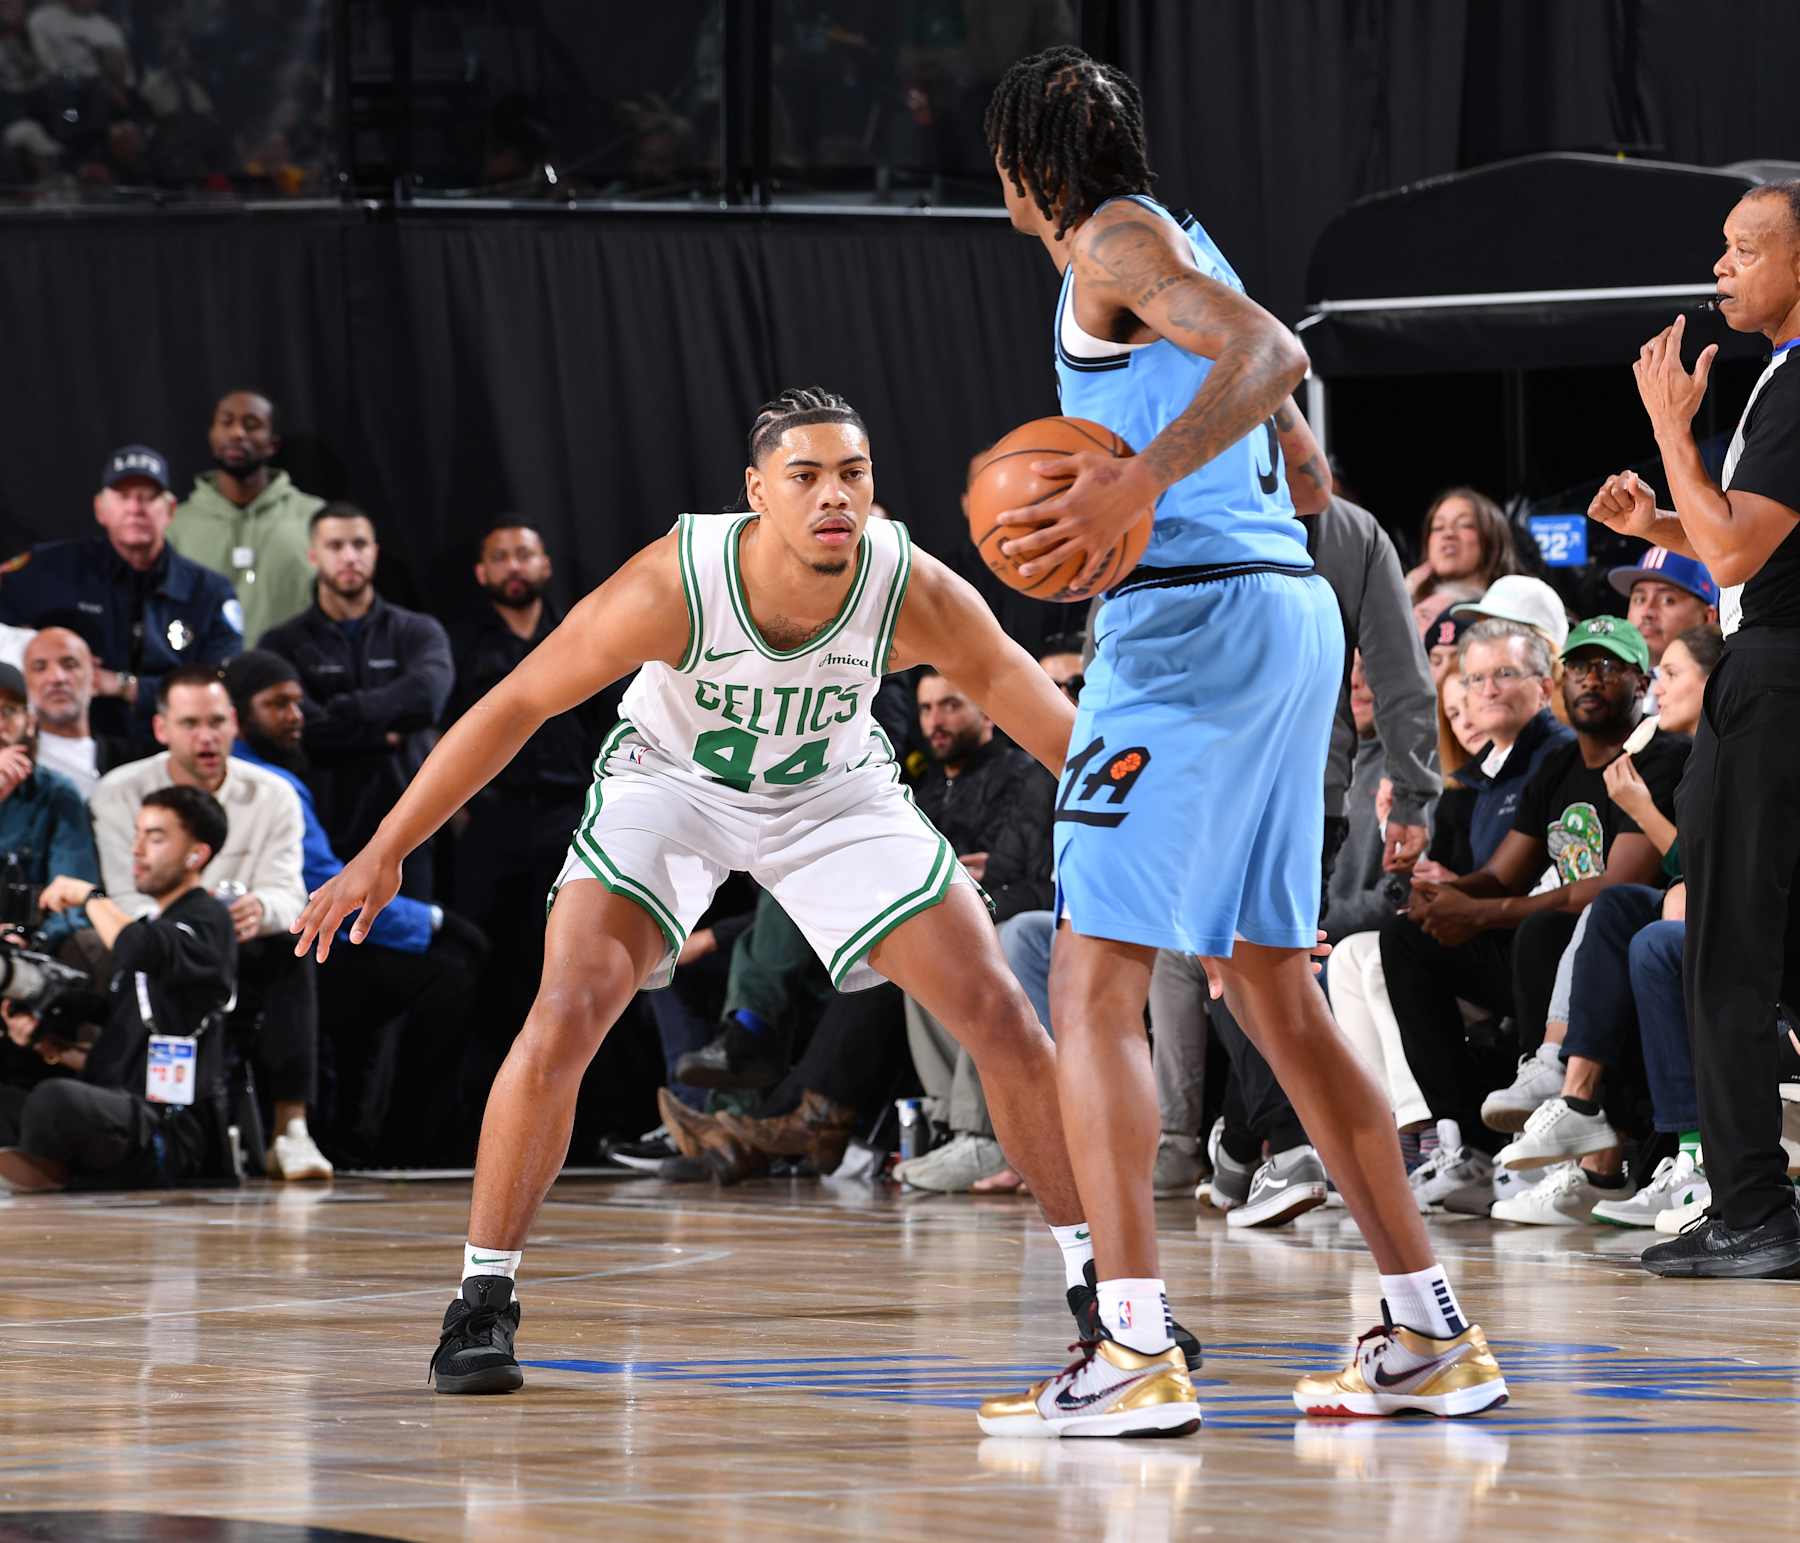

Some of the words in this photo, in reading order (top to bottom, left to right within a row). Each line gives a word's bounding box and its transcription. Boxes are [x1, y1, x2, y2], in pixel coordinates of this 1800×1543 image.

[818, 653, 869, 668] Amica
[695, 680, 865, 736] CELTICS
[693, 727, 830, 793] 44
